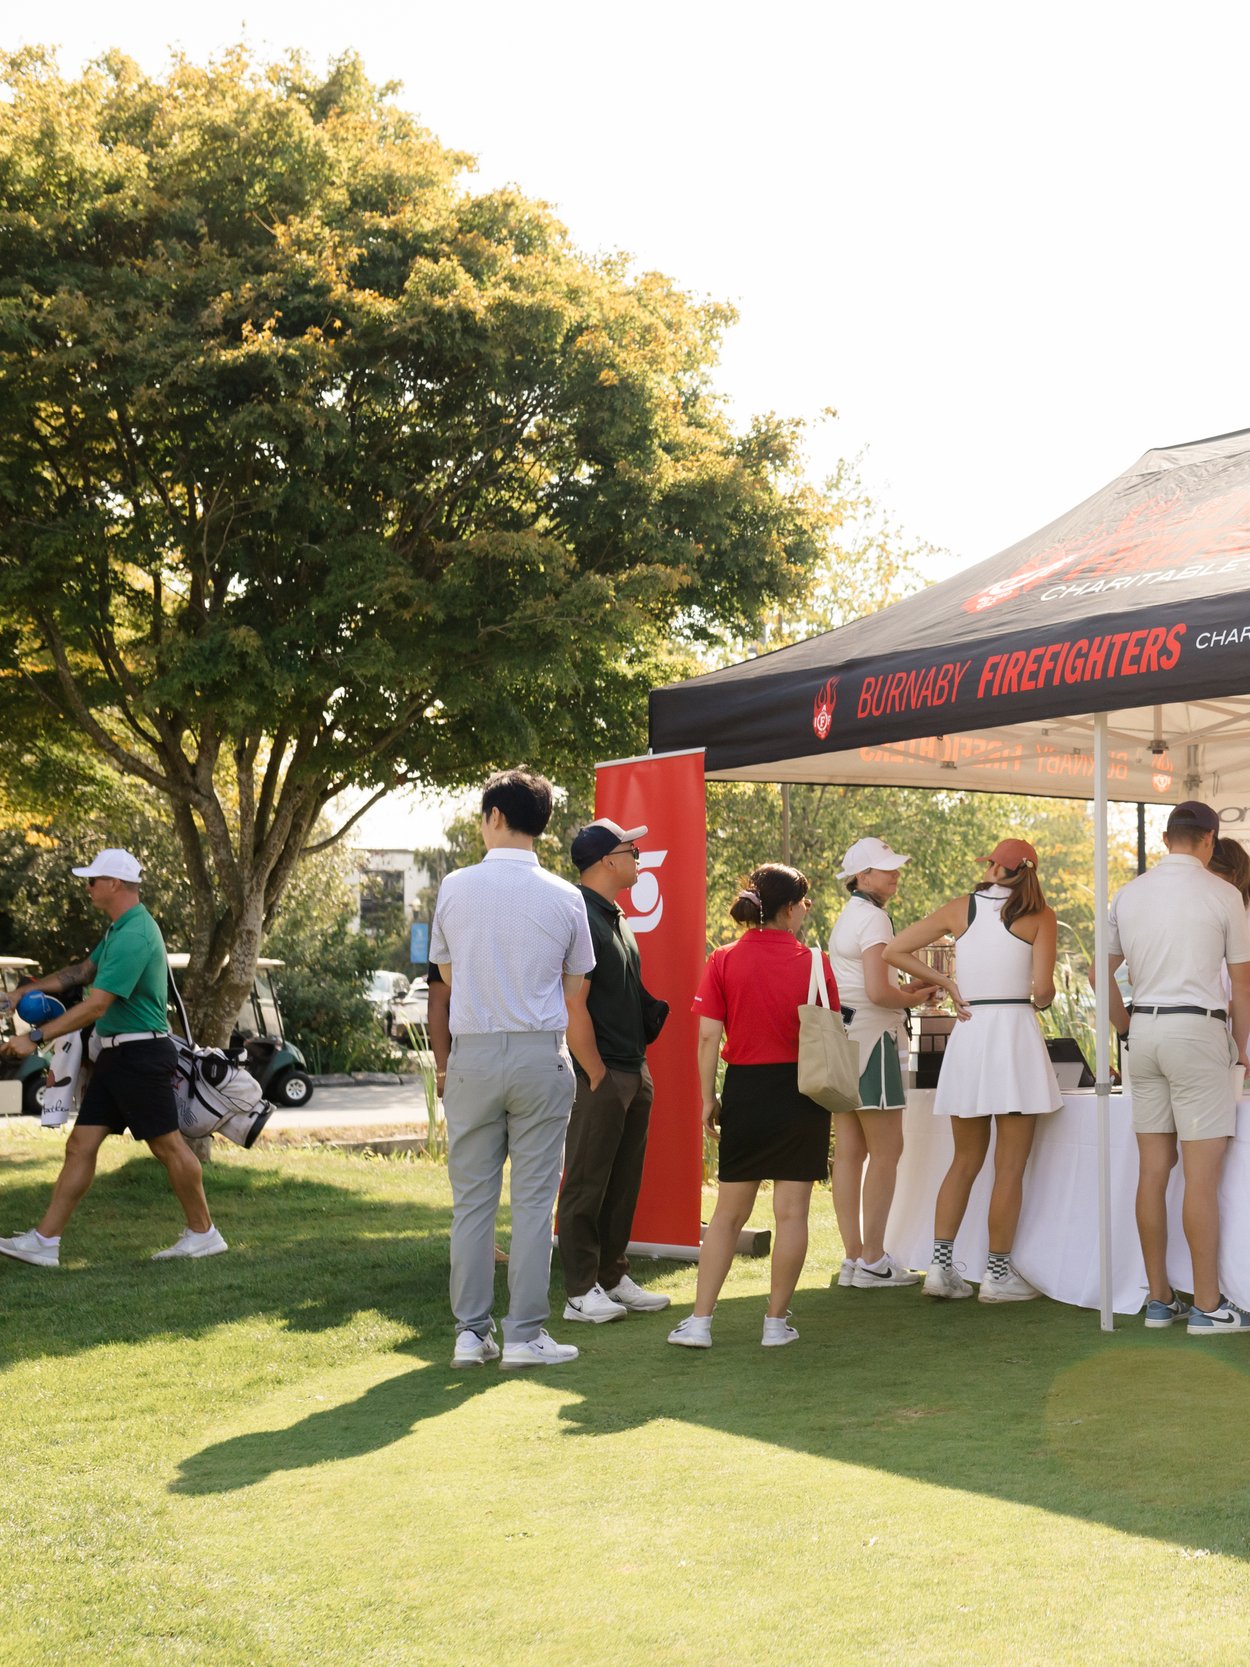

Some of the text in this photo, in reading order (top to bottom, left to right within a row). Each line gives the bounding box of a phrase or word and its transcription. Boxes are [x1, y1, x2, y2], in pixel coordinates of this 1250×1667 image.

[1040, 558, 1243, 603] CHARITABLE
[858, 660, 972, 720] BURNABY
[977, 623, 1187, 700] FIREFIGHTERS
